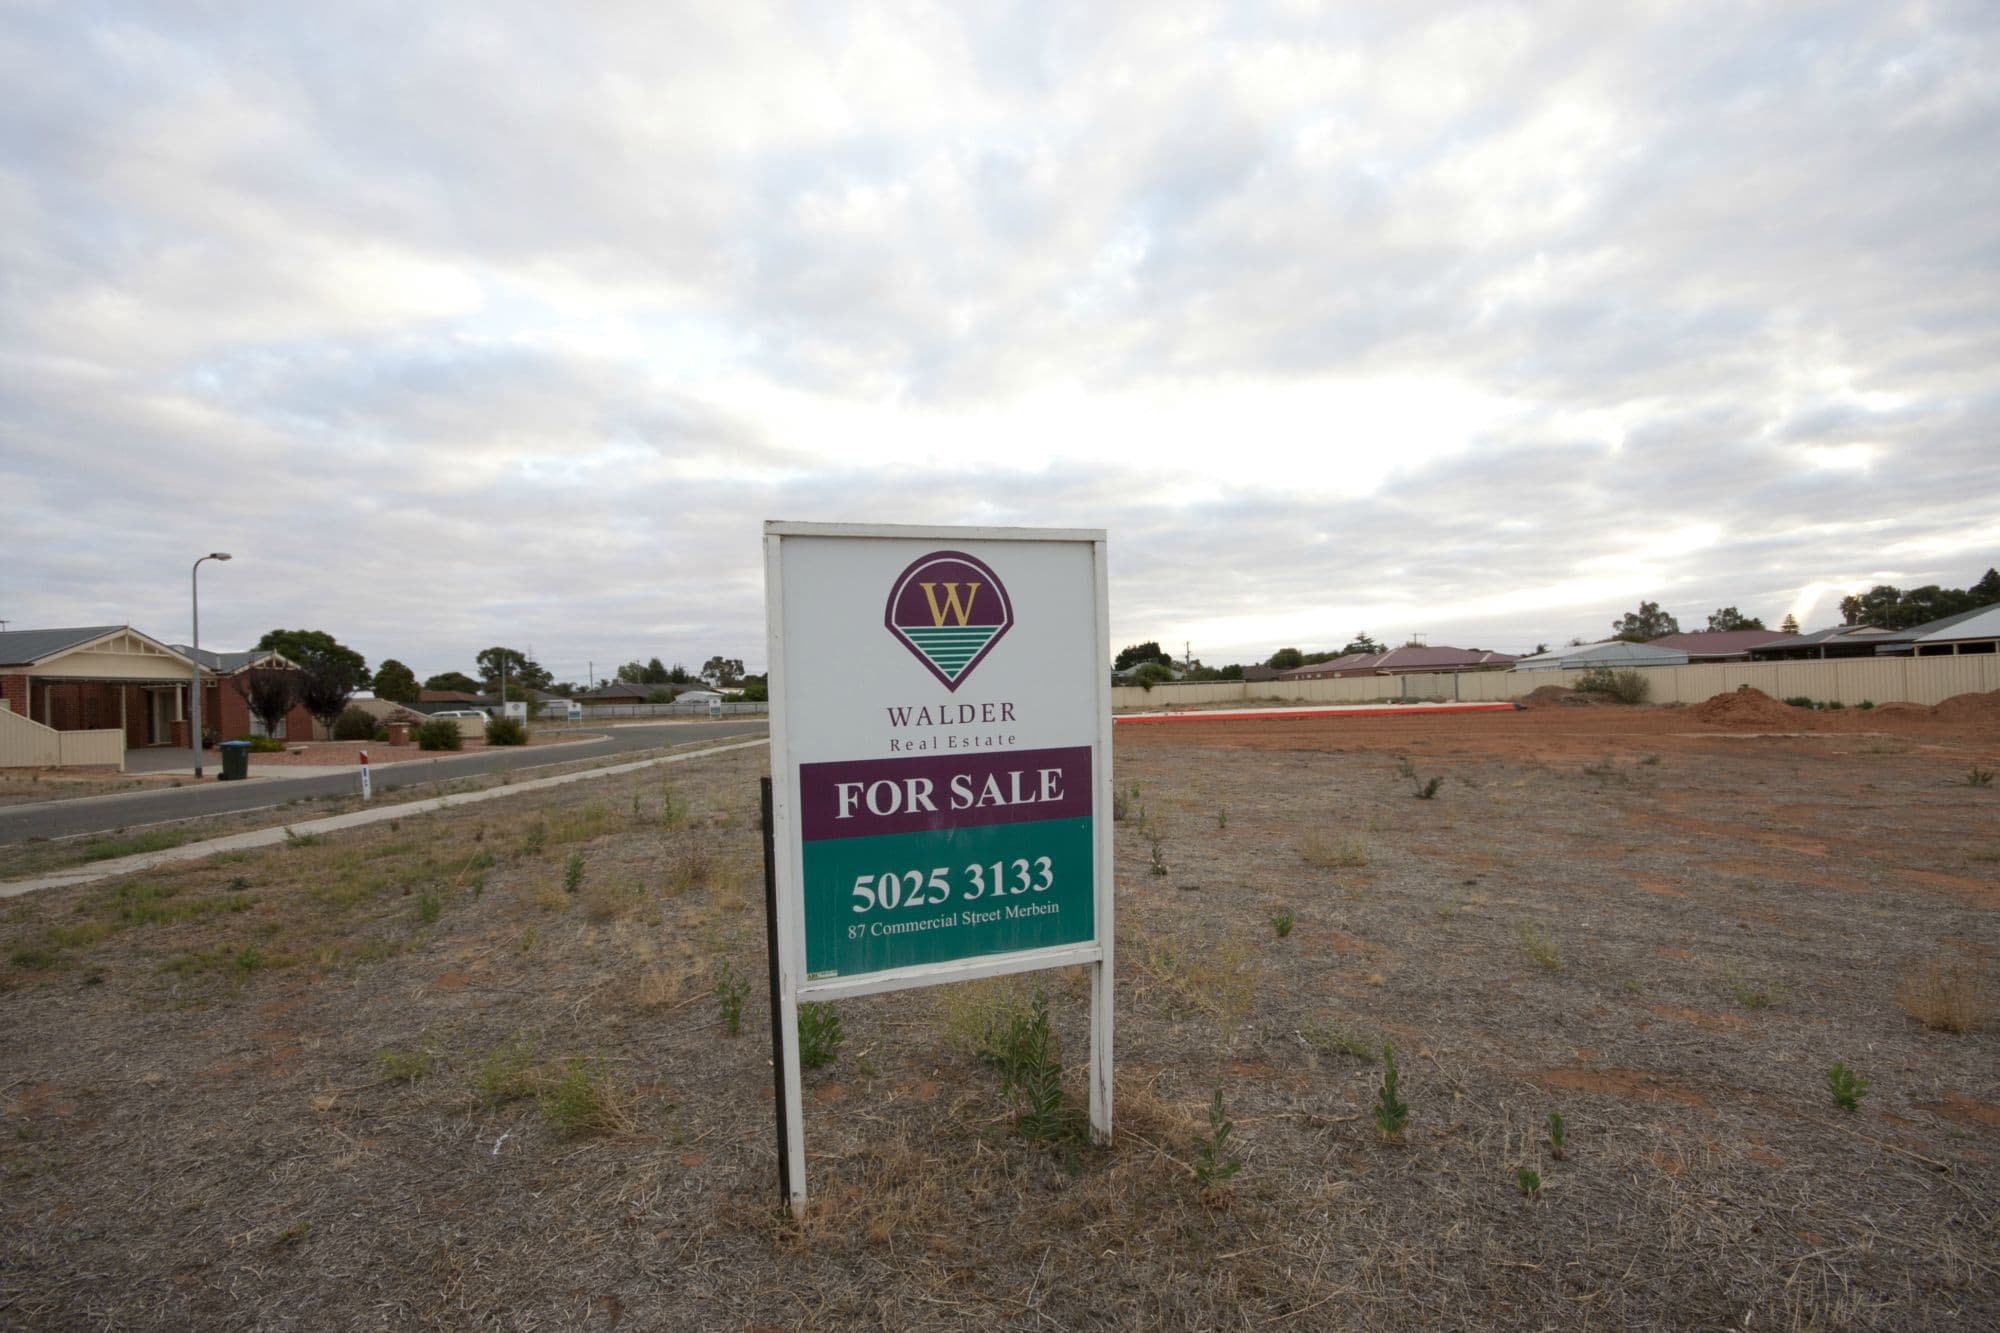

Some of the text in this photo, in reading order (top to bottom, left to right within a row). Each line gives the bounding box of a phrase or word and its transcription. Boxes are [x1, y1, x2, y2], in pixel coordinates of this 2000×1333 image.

[920, 582, 981, 626] W
[887, 702, 1016, 727] WALDER
[890, 734, 1016, 751] Real Estate
[835, 767, 1064, 819] FOR SALE
[852, 856, 1054, 913] 5025 3133
[848, 901, 1060, 939] 87 Commercial Street Merbein
